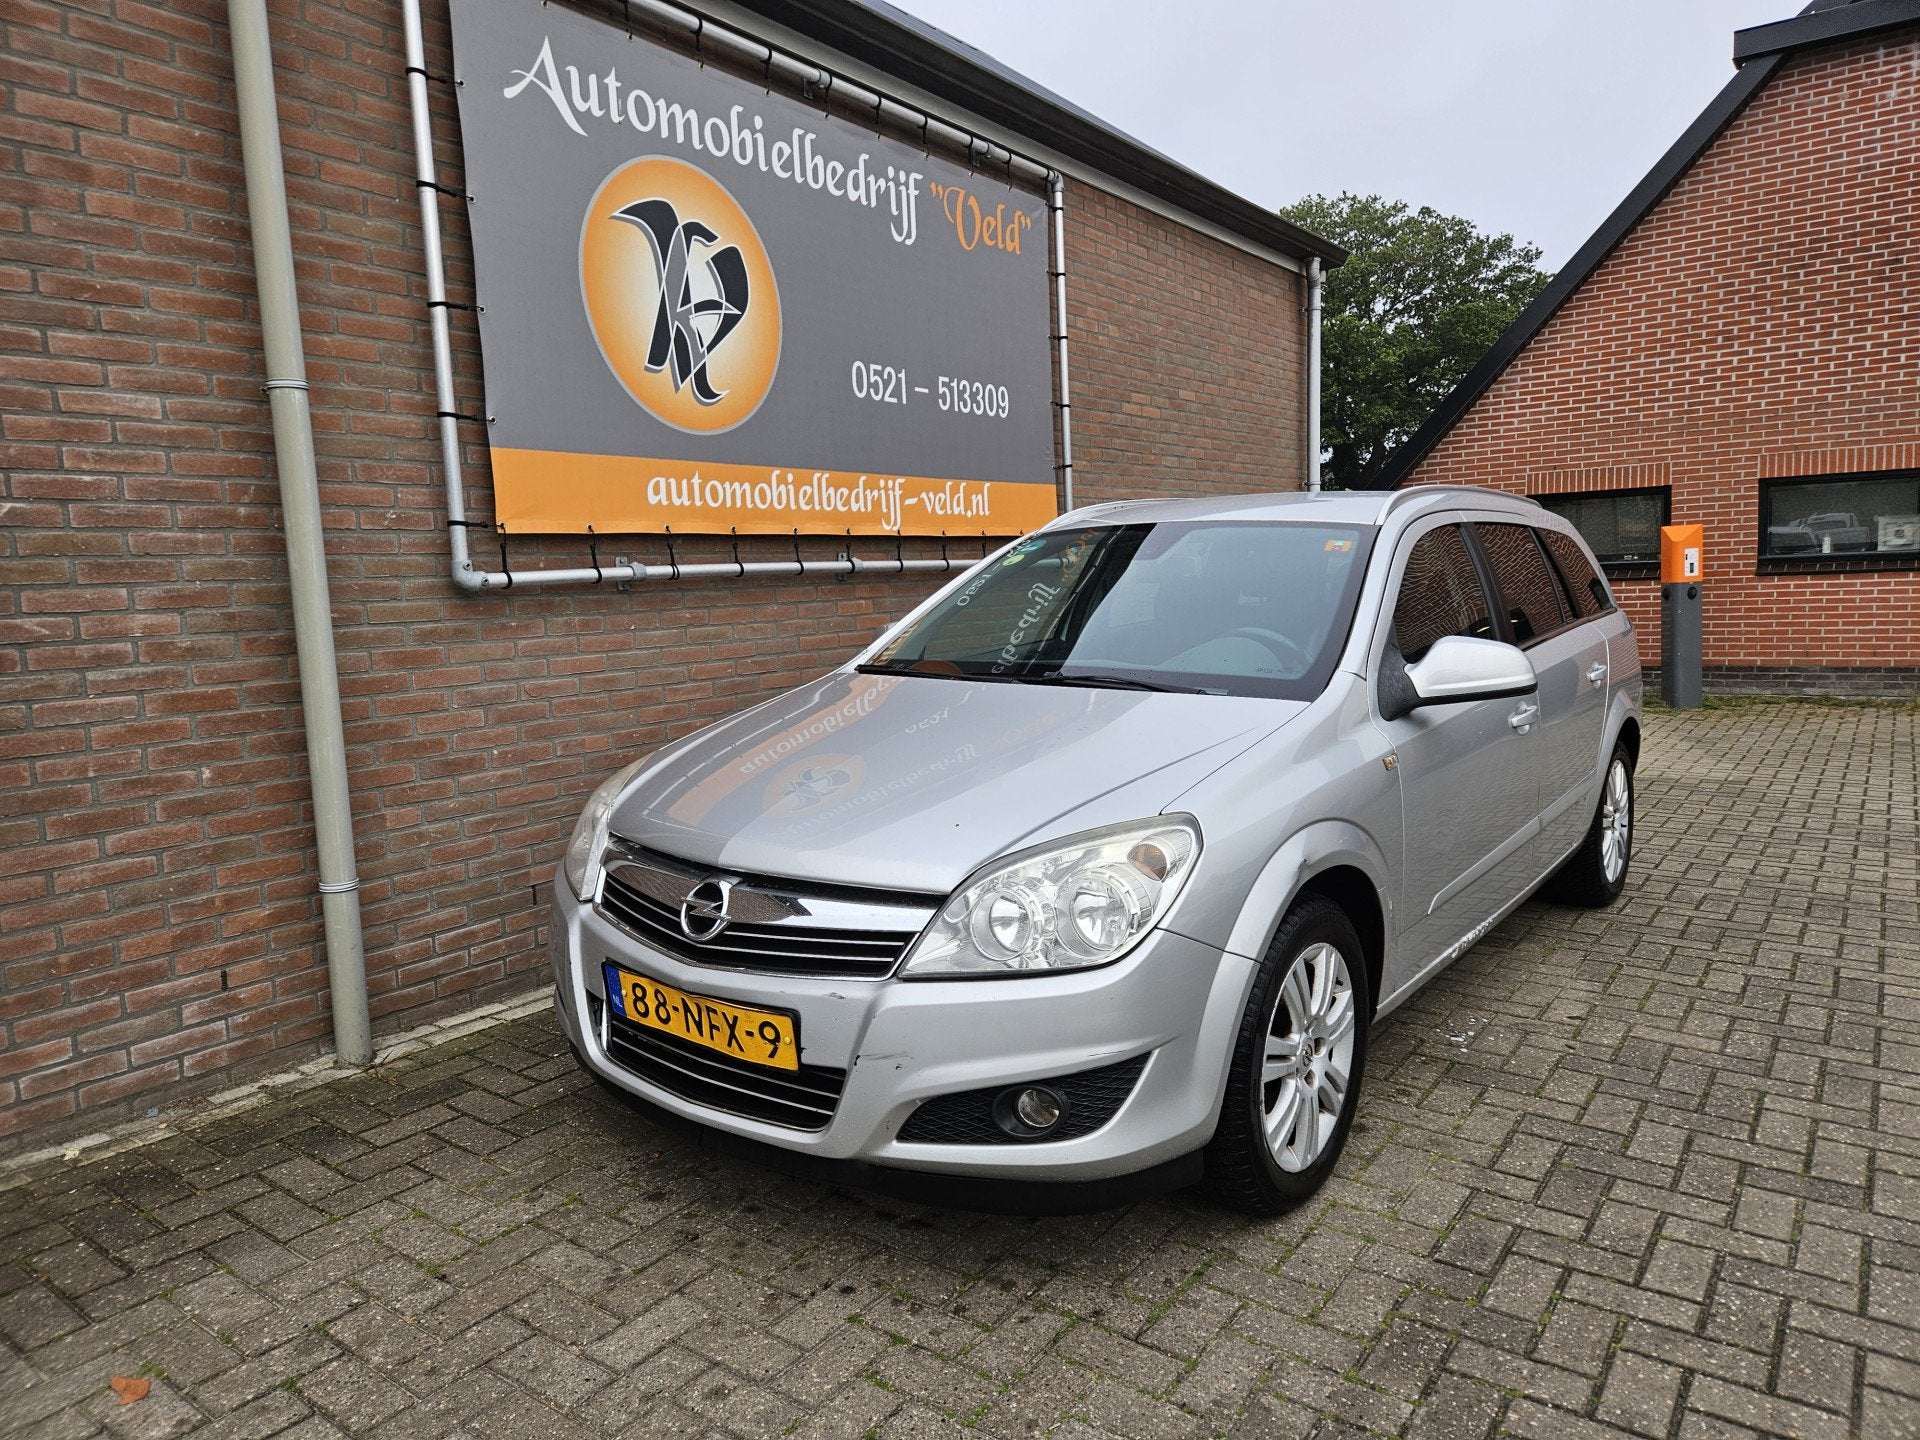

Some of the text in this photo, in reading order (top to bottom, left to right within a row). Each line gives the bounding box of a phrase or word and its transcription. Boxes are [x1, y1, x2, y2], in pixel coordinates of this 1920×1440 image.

[503, 35, 924, 246] Automobielbedrijf
[851, 360, 907, 405] 0521
[938, 375, 1009, 418] 513309
[647, 469, 991, 531] automobielbedrijf-veld.nl
[612, 993, 623, 1008] NL
[631, 982, 781, 1059] 88-NFX-9
